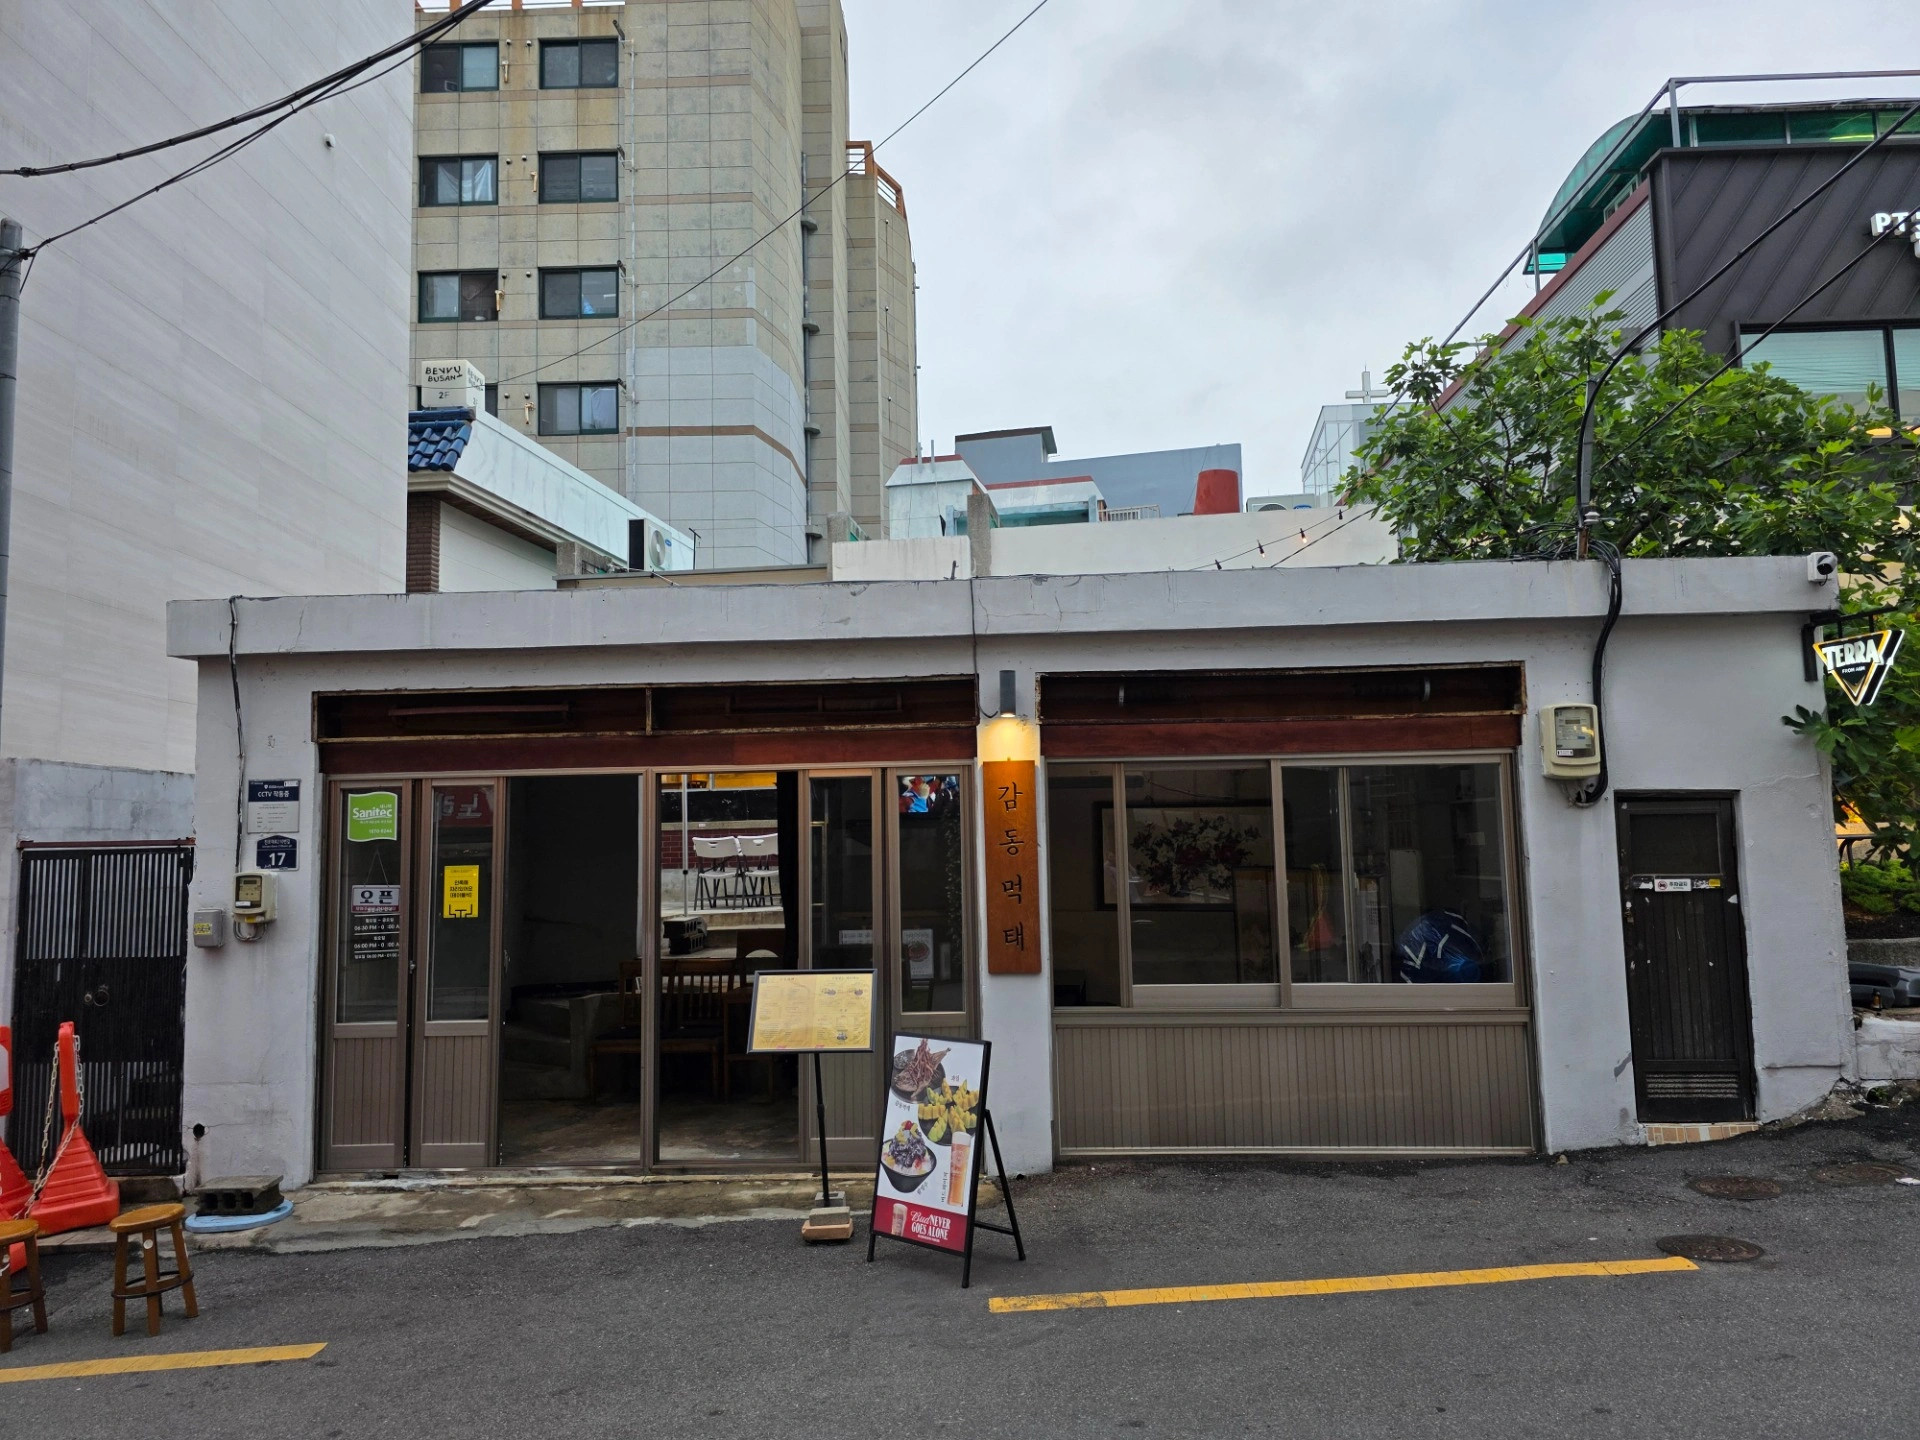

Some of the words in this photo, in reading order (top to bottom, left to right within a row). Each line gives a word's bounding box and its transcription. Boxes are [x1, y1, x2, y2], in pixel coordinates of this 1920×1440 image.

[428, 375, 456, 383] BUSAN
[438, 391, 450, 399] 2F
[1822, 639, 1881, 673] TERRA
[352, 806, 393, 818] Sanitec
[269, 852, 286, 866] 17
[998, 781, 1024, 951] 감동먹태
[360, 890, 392, 904] 오픈
[910, 1210, 930, 1224] Bud
[929, 1214, 951, 1230] NEVER
[911, 1222, 927, 1235] GOES
[927, 1226, 948, 1240] ALONE
